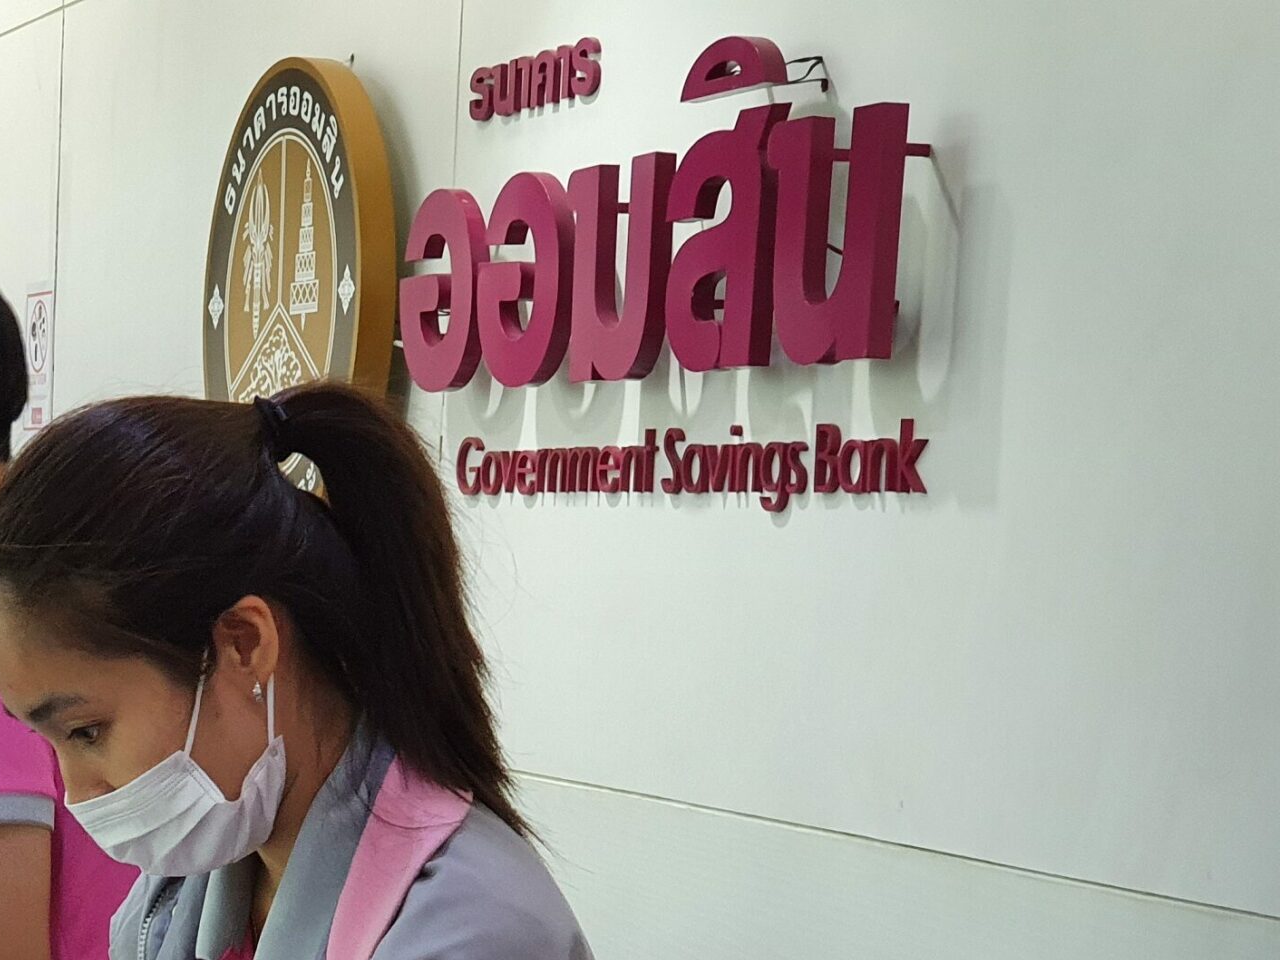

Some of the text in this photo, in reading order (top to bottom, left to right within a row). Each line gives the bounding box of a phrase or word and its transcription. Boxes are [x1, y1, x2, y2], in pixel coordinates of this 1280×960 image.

[469, 37, 602, 122] ธนาคาร
[223, 85, 345, 216] ธนาคารออมสิน
[399, 36, 910, 393] ออมสิน
[456, 418, 930, 513] Government Savings Bank
